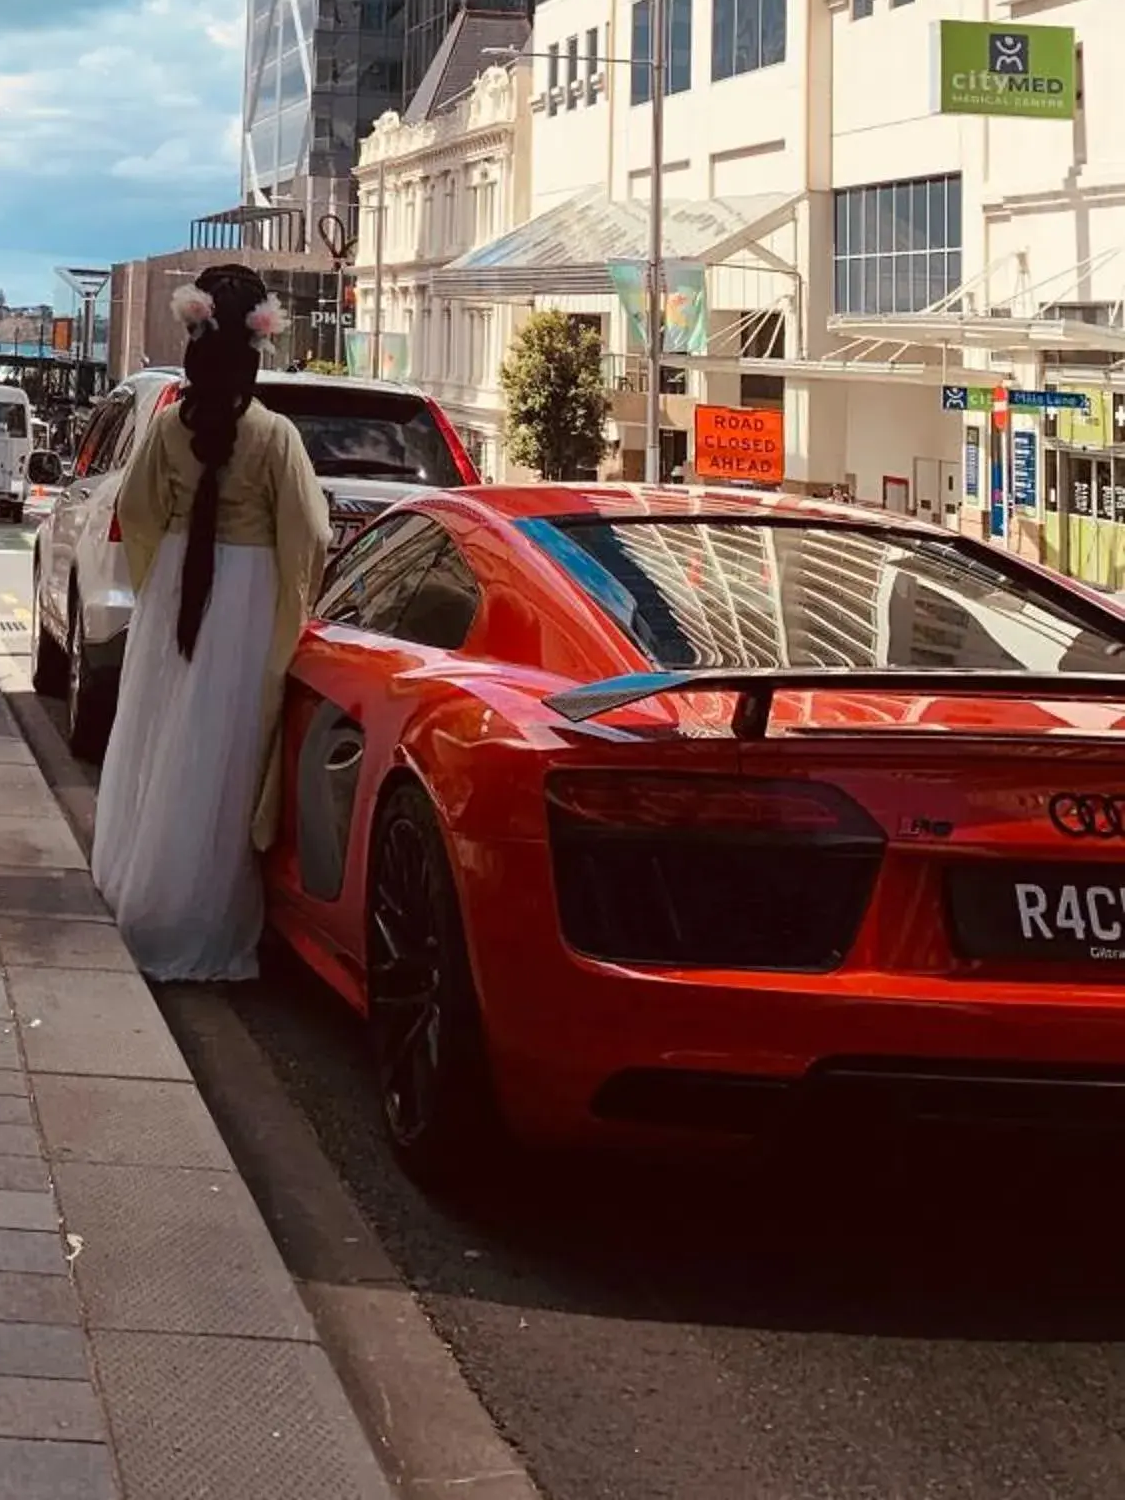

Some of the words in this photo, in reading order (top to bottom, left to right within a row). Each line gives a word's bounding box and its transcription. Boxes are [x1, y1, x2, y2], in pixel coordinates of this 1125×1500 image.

[952, 70, 1064, 95] cityMED
[714, 415, 765, 432] ROAD
[704, 435, 776, 453] CLOSED
[710, 455, 773, 473] AHEAD
